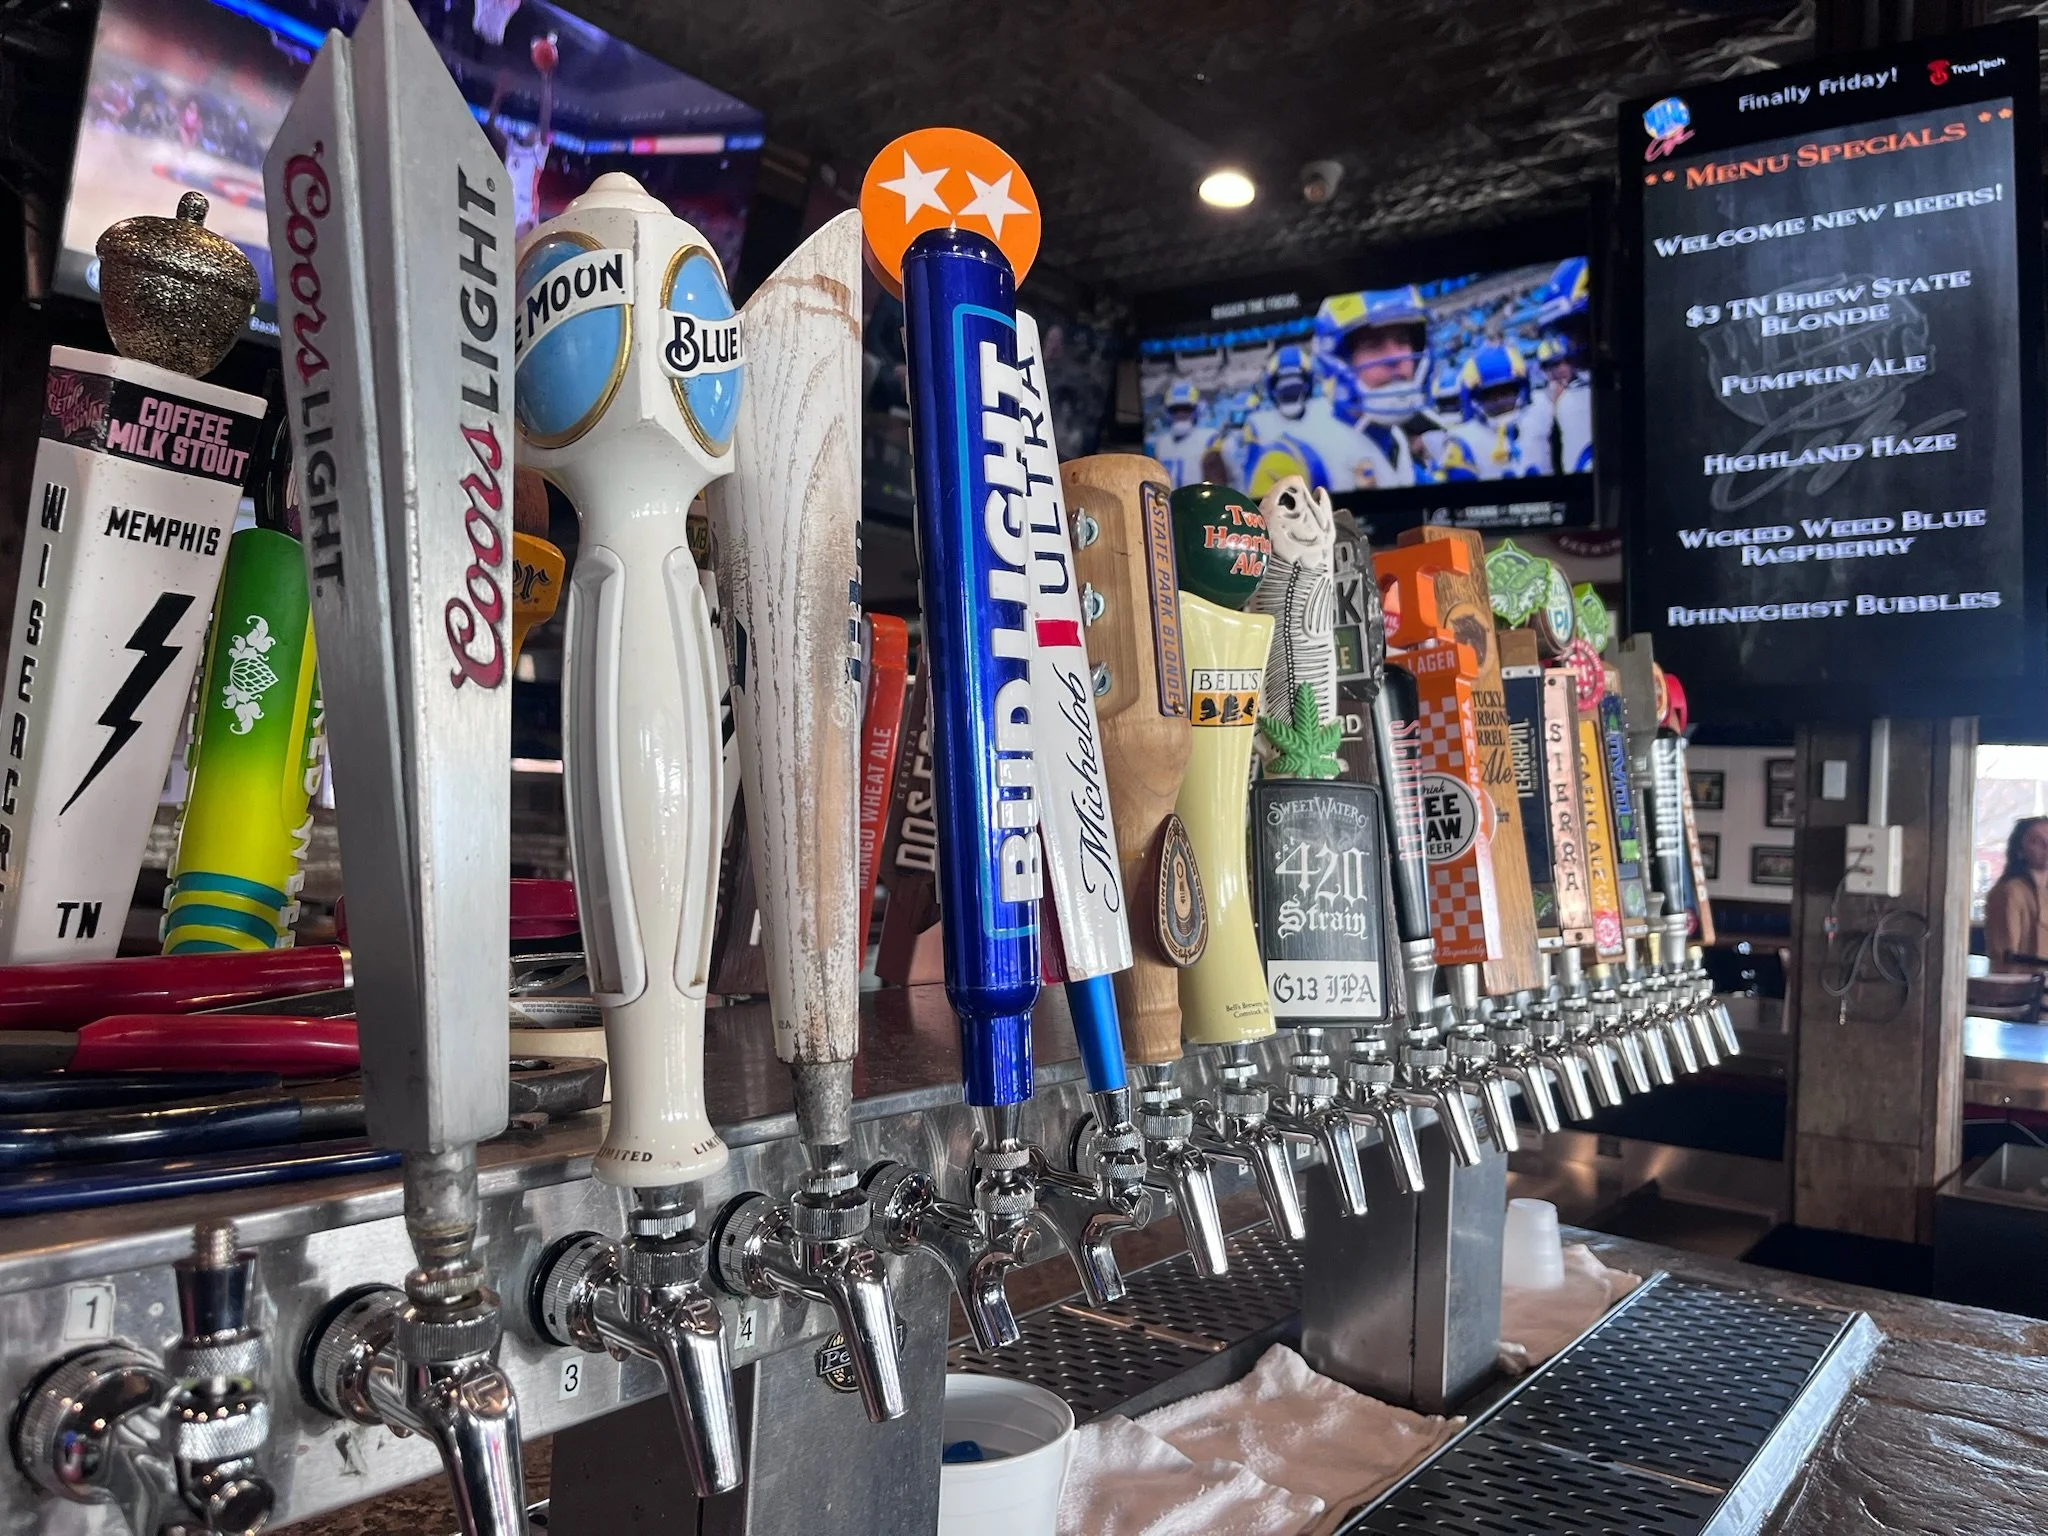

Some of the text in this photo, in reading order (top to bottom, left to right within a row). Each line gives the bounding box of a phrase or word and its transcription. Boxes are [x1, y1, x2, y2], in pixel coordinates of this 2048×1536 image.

[1739, 67, 1898, 112] Finally Friday!
[1811, 203, 1887, 232] NEW
[1894, 183, 2003, 218] BEERS!
[527, 254, 624, 338] MOON
[1686, 304, 1720, 328] $3
[1726, 297, 1769, 321] TN
[283, 140, 345, 597] Coors LIGHT
[138, 396, 233, 447] COFFEE
[445, 165, 505, 689] Coors LIGHT
[106, 419, 249, 479] MILK STOUT
[104, 506, 221, 556] MEMPHIS
[1225, 504, 1266, 529] Two
[1230, 552, 1264, 576] Ale
[980, 341, 1044, 903] BUD LIGHT
[1153, 506, 1180, 703] STATE PARK BLONDE
[1018, 355, 1121, 915] Michelob ULTRA
[0, 482, 69, 922] WISEACR
[1199, 673, 1258, 691] BELL'S
[1471, 690, 1504, 708] TUCKY
[1474, 711, 1508, 726] RBON
[1476, 729, 1506, 746] RREL
[872, 727, 891, 762] ALE
[897, 729, 918, 799] CERVEZA
[1480, 749, 1513, 785] Ale
[863, 762, 886, 823] WHEAT
[1425, 793, 1460, 817] EE
[1550, 723, 1579, 891] SIERRA
[1426, 817, 1462, 842] AW
[1275, 842, 1370, 908] 420
[57, 902, 102, 939] TN
[1278, 894, 1368, 940] Strain
[1274, 972, 1376, 1004] G13 IPA
[694, 1135, 722, 1155] LIMI
[86, 1295, 99, 1328] 1
[741, 1316, 753, 1341] 4
[563, 1364, 579, 1393] 3
